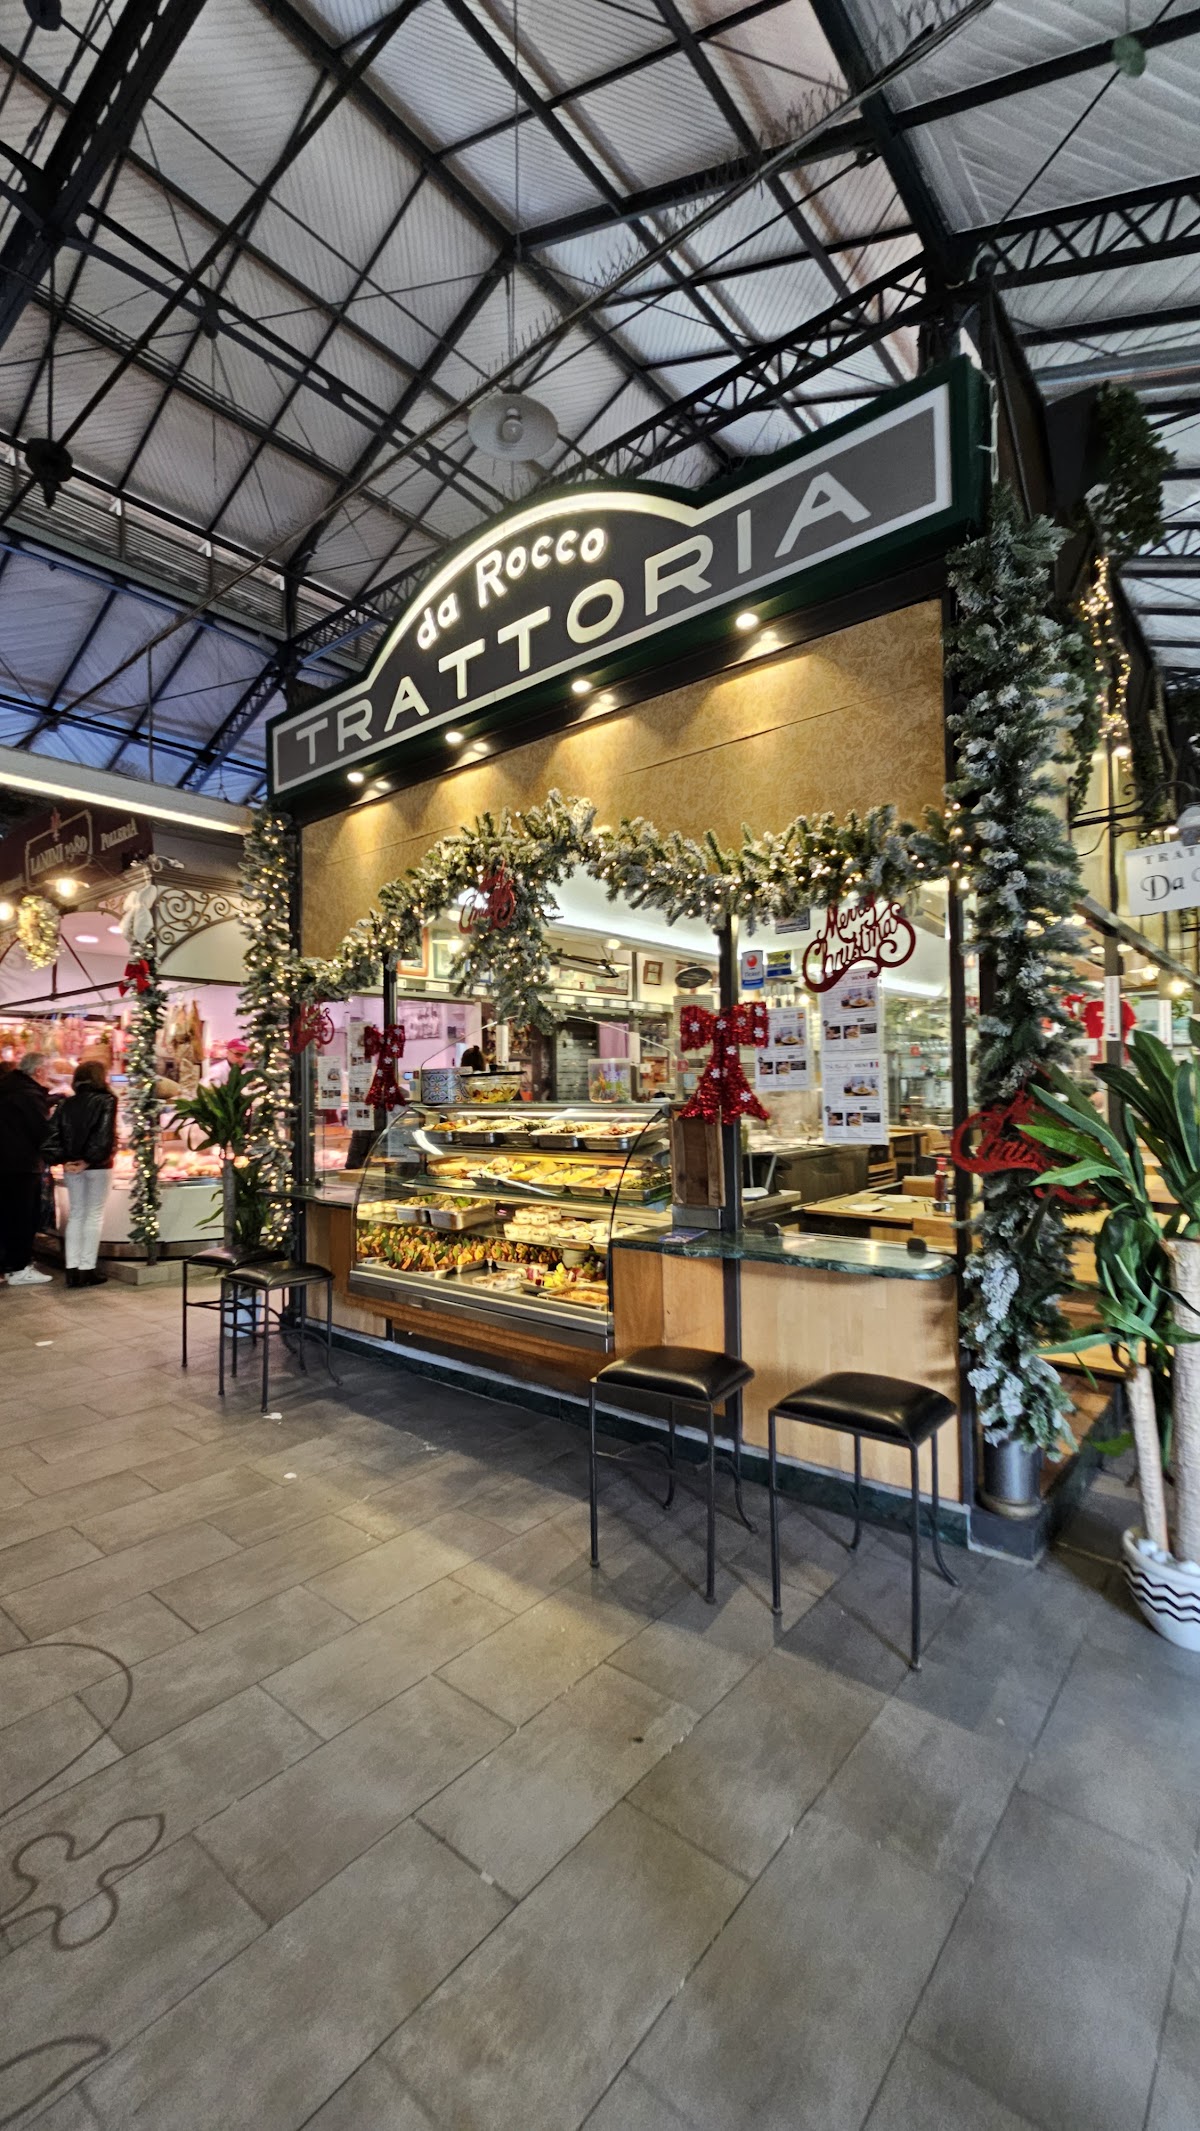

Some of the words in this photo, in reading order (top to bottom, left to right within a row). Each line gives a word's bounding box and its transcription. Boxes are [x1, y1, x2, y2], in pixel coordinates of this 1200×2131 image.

[296, 471, 872, 765] TRATTORIA
[416, 593, 460, 650] da
[475, 527, 609, 609] Rocco
[1140, 874, 1185, 902] Da
